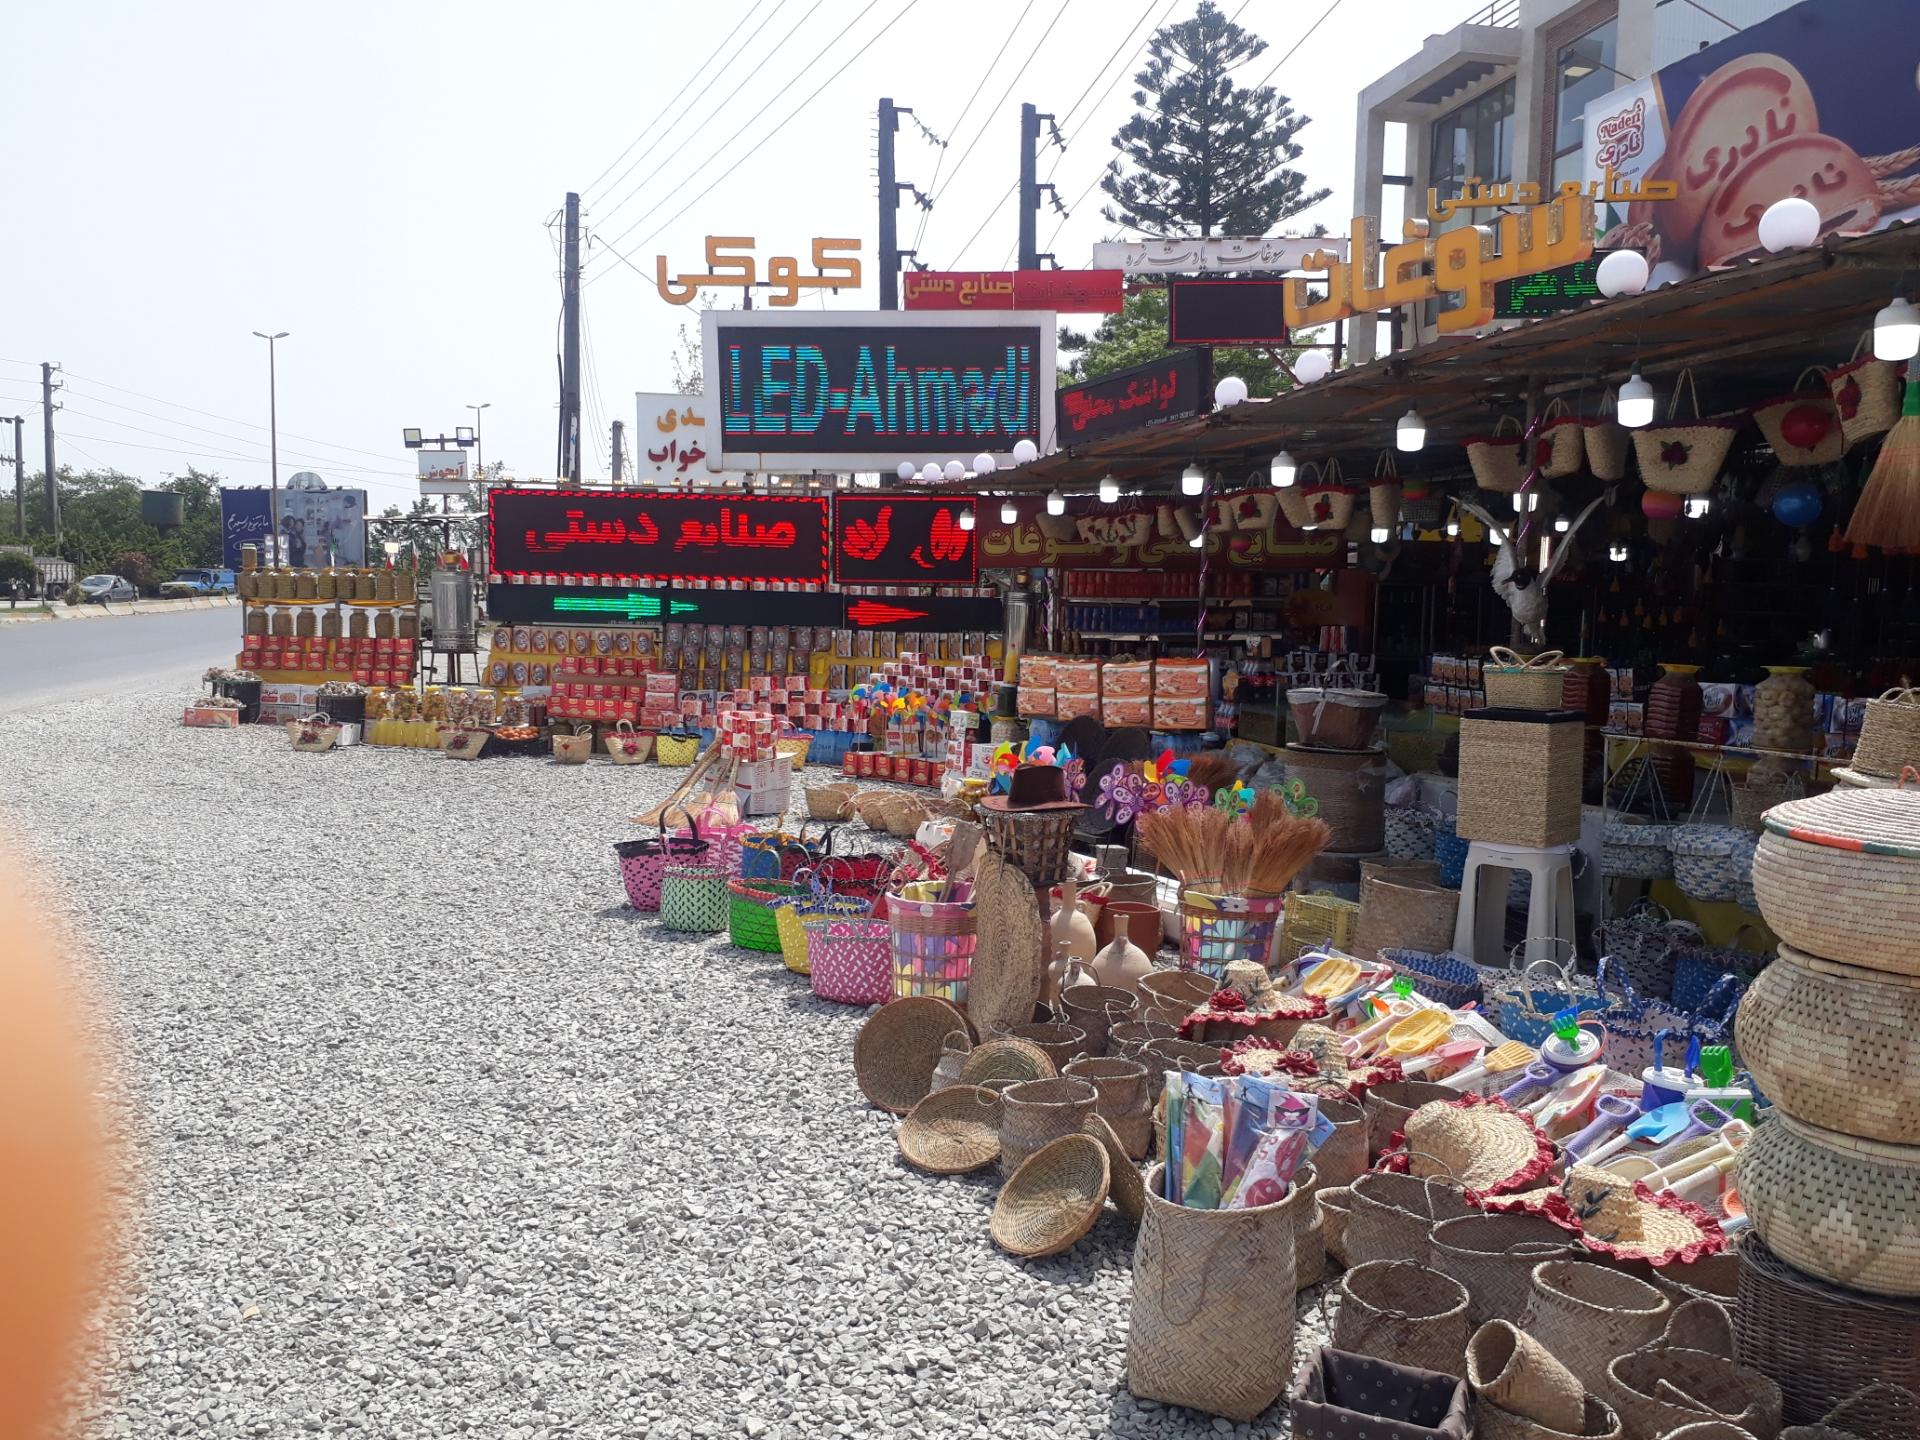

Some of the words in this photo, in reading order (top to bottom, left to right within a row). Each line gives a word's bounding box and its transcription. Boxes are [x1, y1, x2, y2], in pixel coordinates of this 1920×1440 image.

[1600, 104, 1642, 138] Naderi
[1599, 131, 1642, 167] نادری
[1686, 97, 1797, 192] نادری
[1427, 176, 1542, 222] دستی
[656, 235, 862, 307] کوکی
[905, 273, 955, 300] دستی
[1283, 195, 1597, 334] سوغات
[958, 273, 1014, 305] صنایع
[724, 345, 1034, 438] LED-Ahmadi
[525, 509, 660, 553] دستی
[673, 508, 797, 554] صنایع
